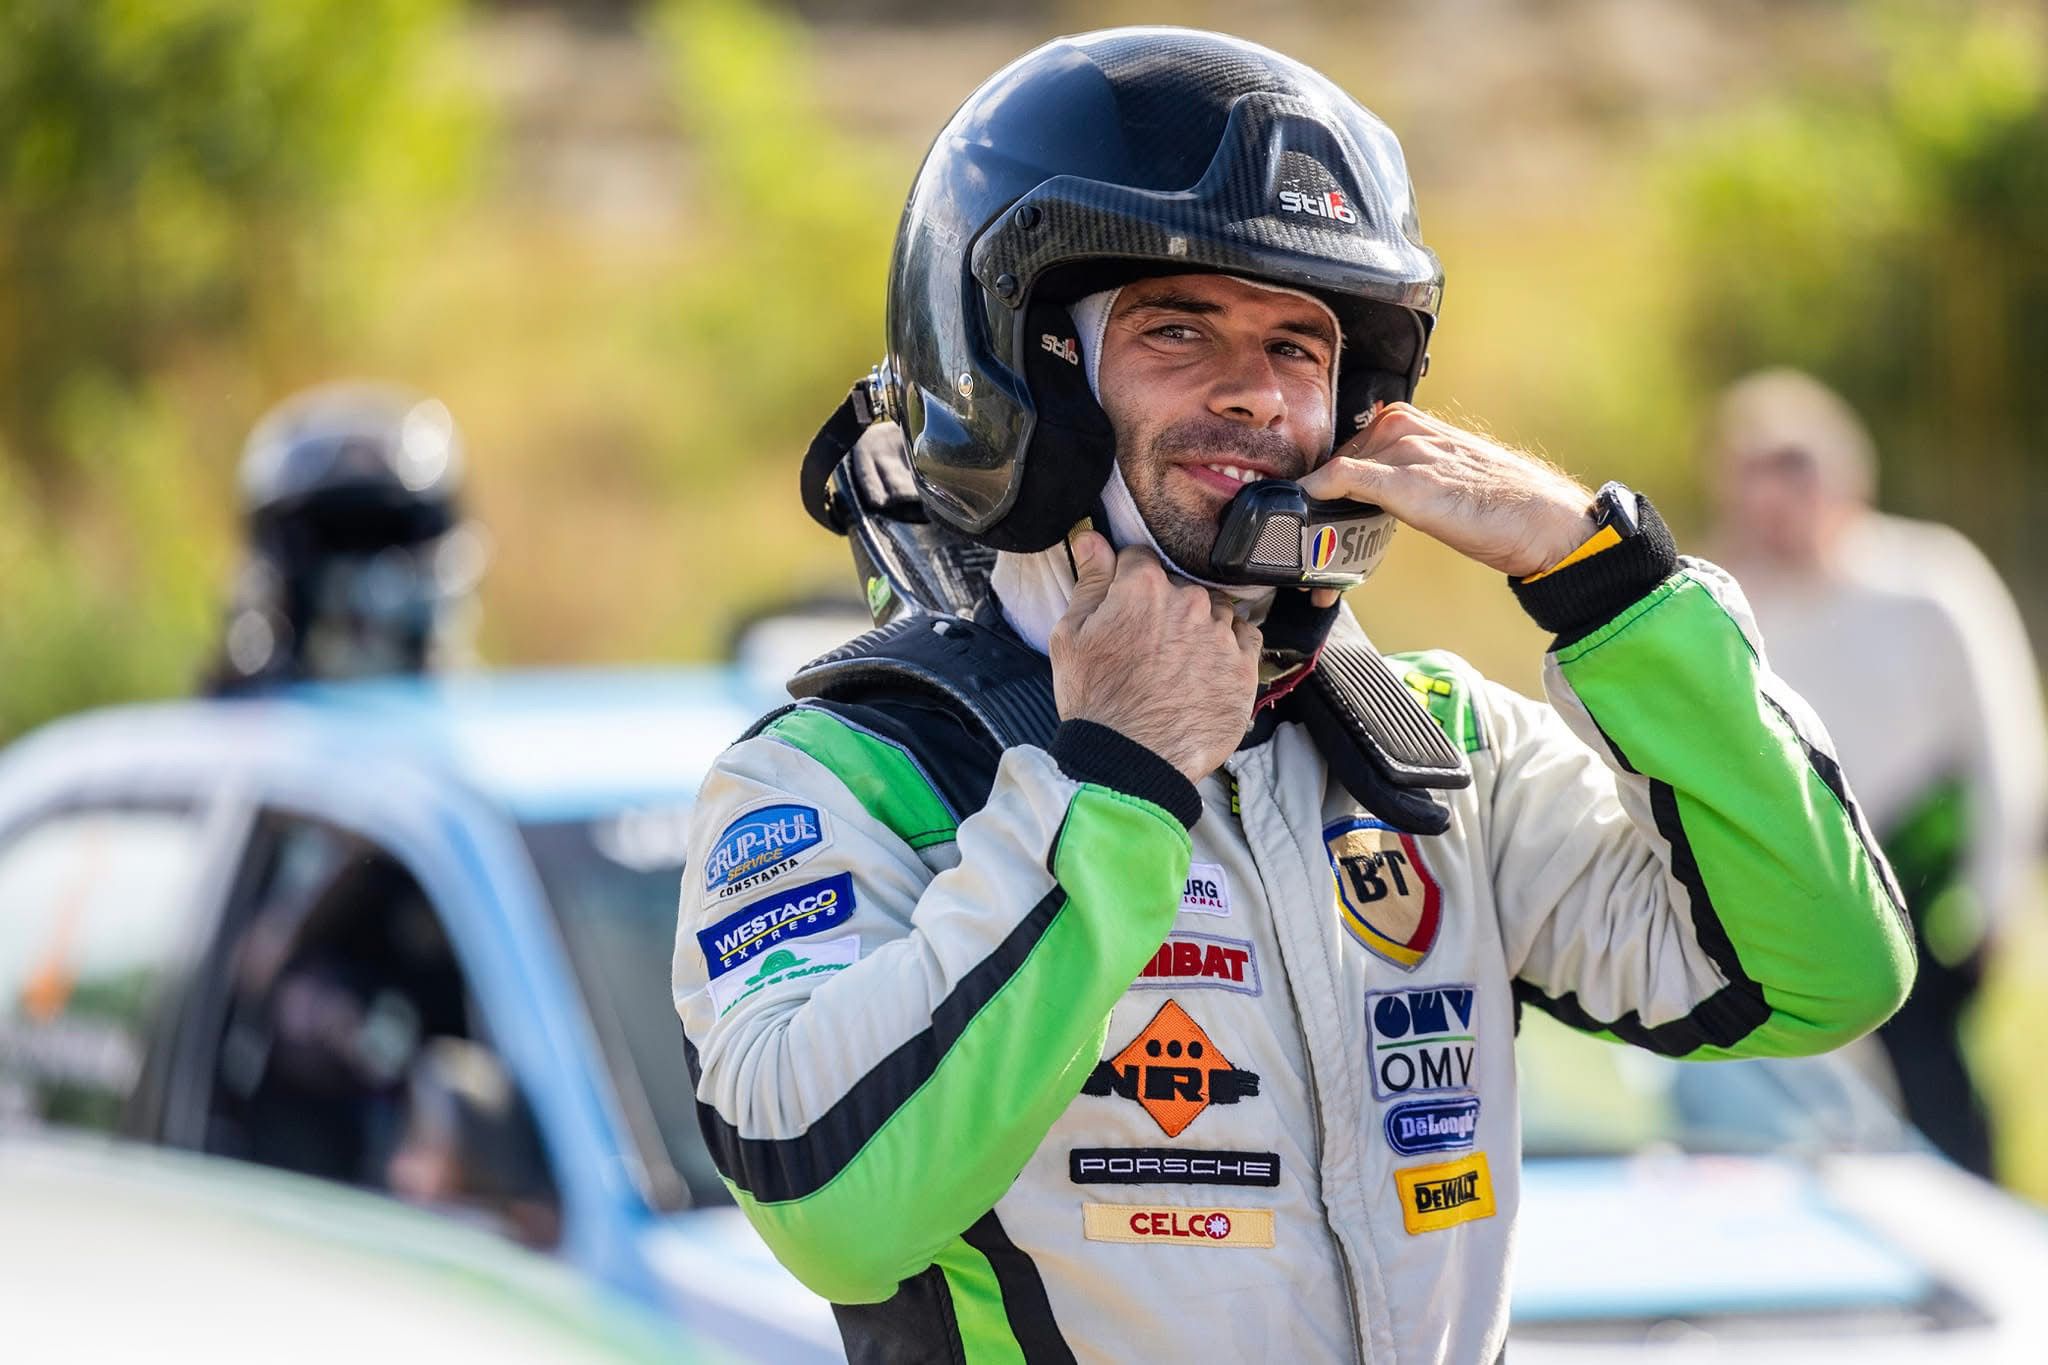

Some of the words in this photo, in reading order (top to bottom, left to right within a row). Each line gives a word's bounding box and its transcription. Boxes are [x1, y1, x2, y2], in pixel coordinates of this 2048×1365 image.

[1279, 191, 1356, 224] Stilo
[706, 814, 818, 886] GRUP-RUL
[727, 847, 784, 881] SERVICE
[720, 858, 799, 898] CONSTANTA
[1339, 850, 1409, 904] BT
[714, 888, 838, 956] WESTACO
[1380, 1046, 1474, 1092] OMV
[1080, 1158, 1272, 1177] PORSCHE
